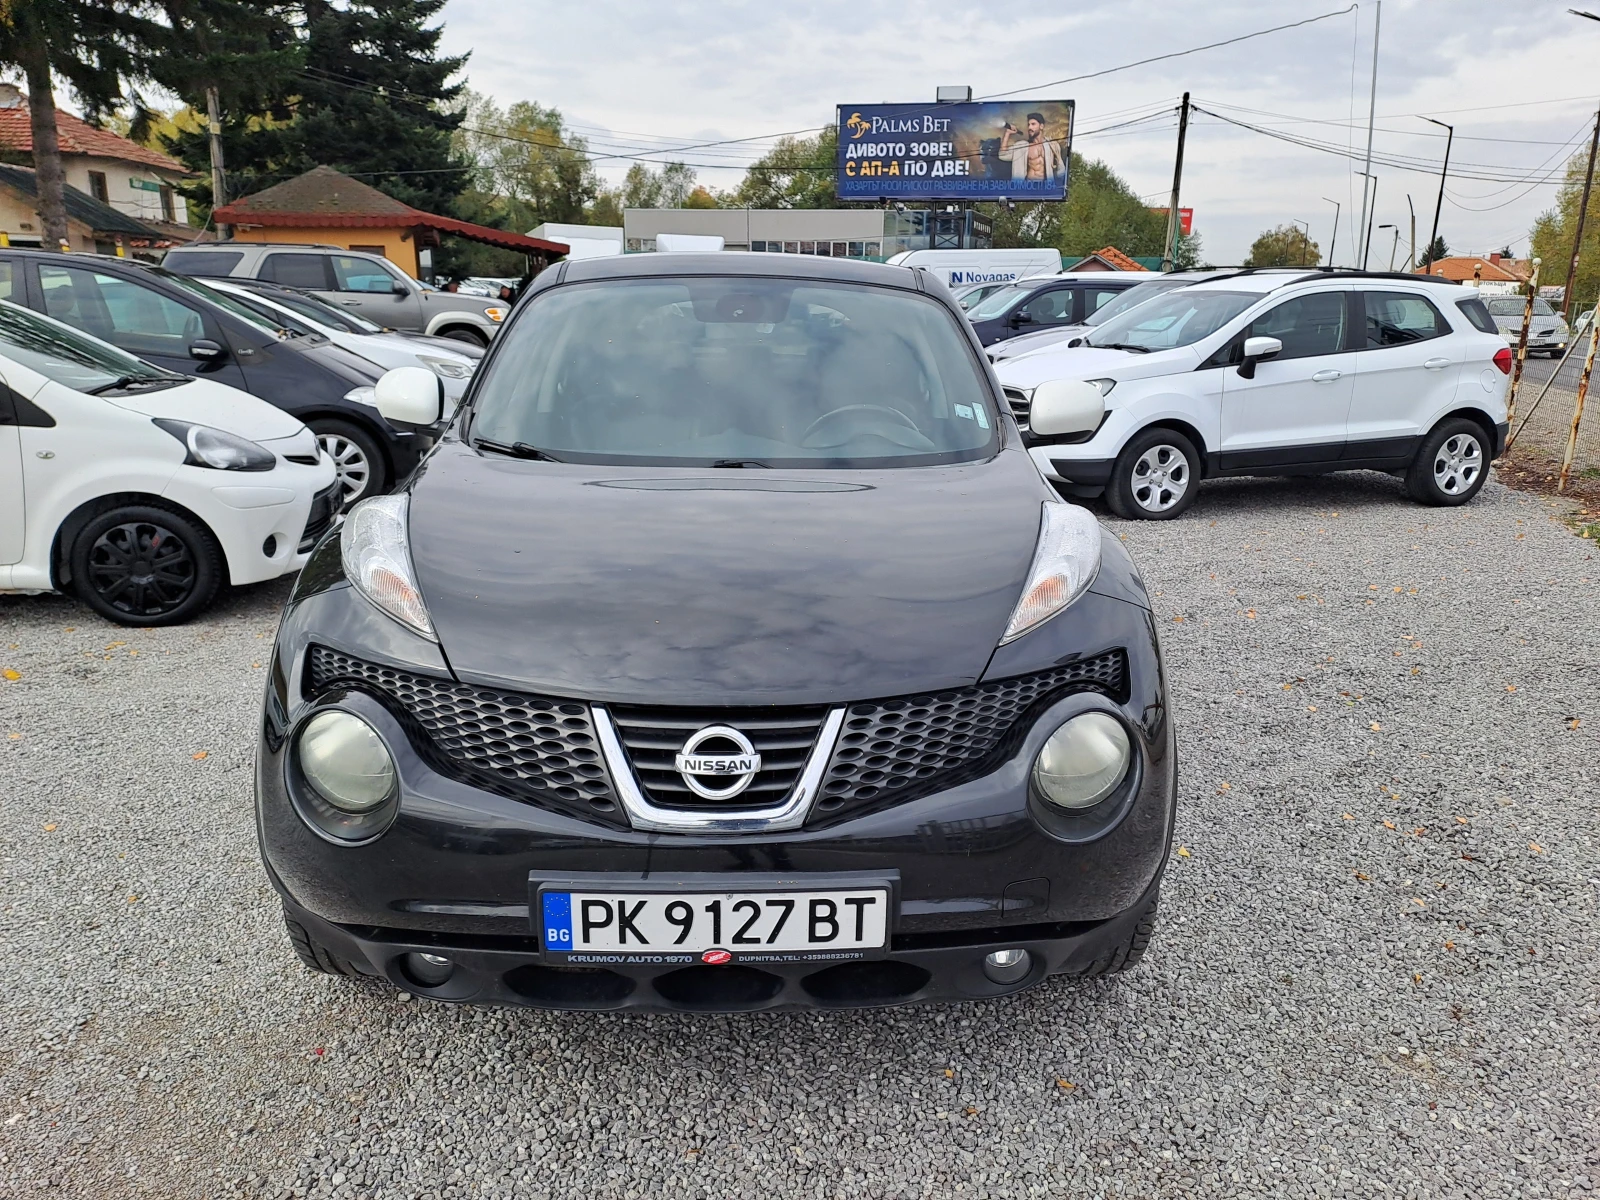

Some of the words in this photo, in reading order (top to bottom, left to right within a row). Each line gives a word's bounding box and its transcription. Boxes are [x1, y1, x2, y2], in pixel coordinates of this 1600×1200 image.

[845, 143, 906, 159] ДИВОТО
[909, 142, 953, 157] ЗОВЕ!
[845, 161, 856, 176] С
[860, 160, 900, 176] АП-А
[904, 160, 928, 176] ПО
[931, 160, 970, 178] ДВЕ!
[845, 180, 880, 191] ХАЗАРТЪТ
[881, 180, 903, 191] НОСИ
[903, 180, 923, 191] РИСК
[923, 180, 934, 191] ОТ
[934, 180, 977, 191] РАЗВИВАНЕ
[979, 180, 989, 191] НА
[1044, 180, 1057, 191] 18+
[966, 271, 1016, 283] Novagas
[684, 759, 752, 771] NISSAN
[581, 899, 650, 945] PK
[664, 899, 795, 945] 9127
[808, 897, 876, 943] BT
[547, 928, 570, 942] BG
[567, 955, 625, 964] KRUMOV
[626, 955, 663, 964] AUTO
[664, 955, 693, 964] 1970
